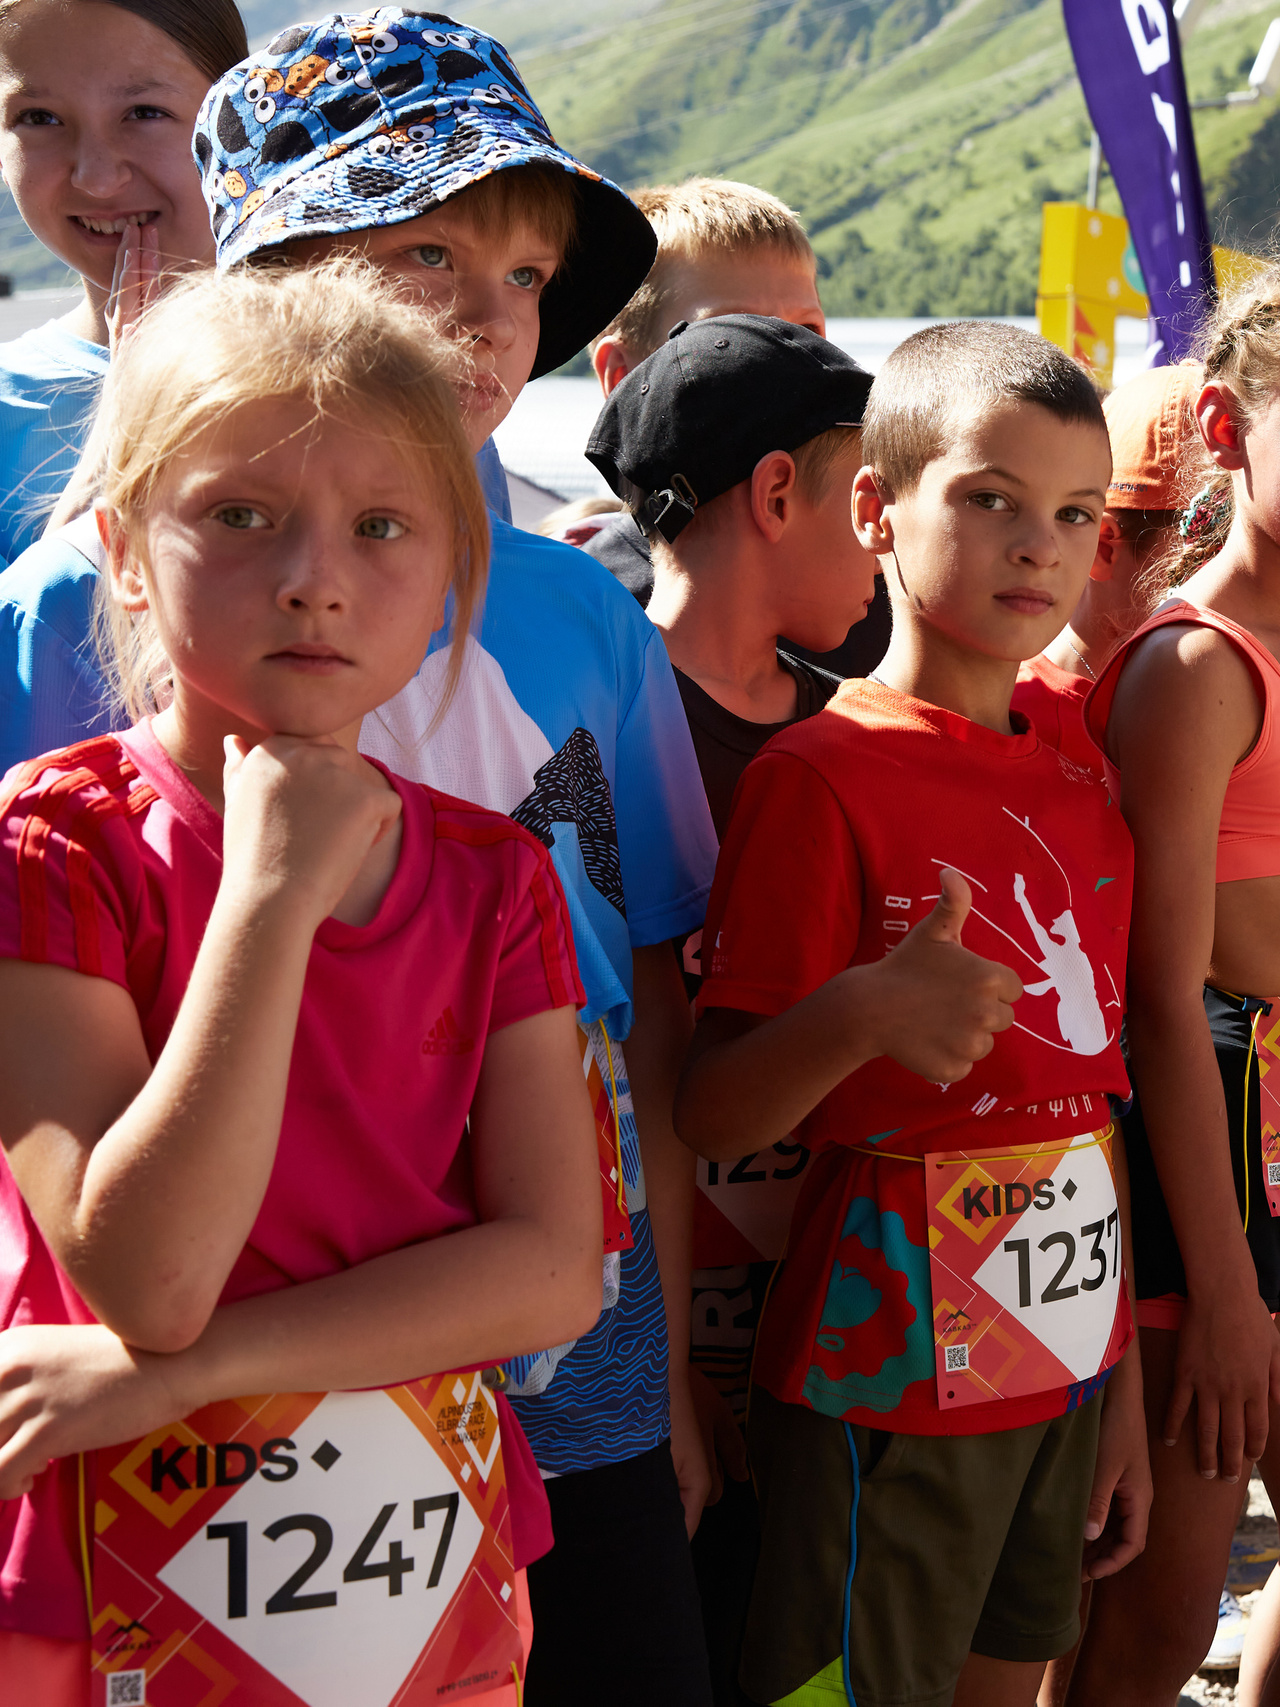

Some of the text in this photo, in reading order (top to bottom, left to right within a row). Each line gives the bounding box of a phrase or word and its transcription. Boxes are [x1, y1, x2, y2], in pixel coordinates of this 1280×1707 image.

[962, 1177, 1056, 1220] KIDS
[1003, 1206, 1118, 1308] 1237
[150, 1437, 299, 1492] KIDS
[206, 1491, 460, 1620] 1247
